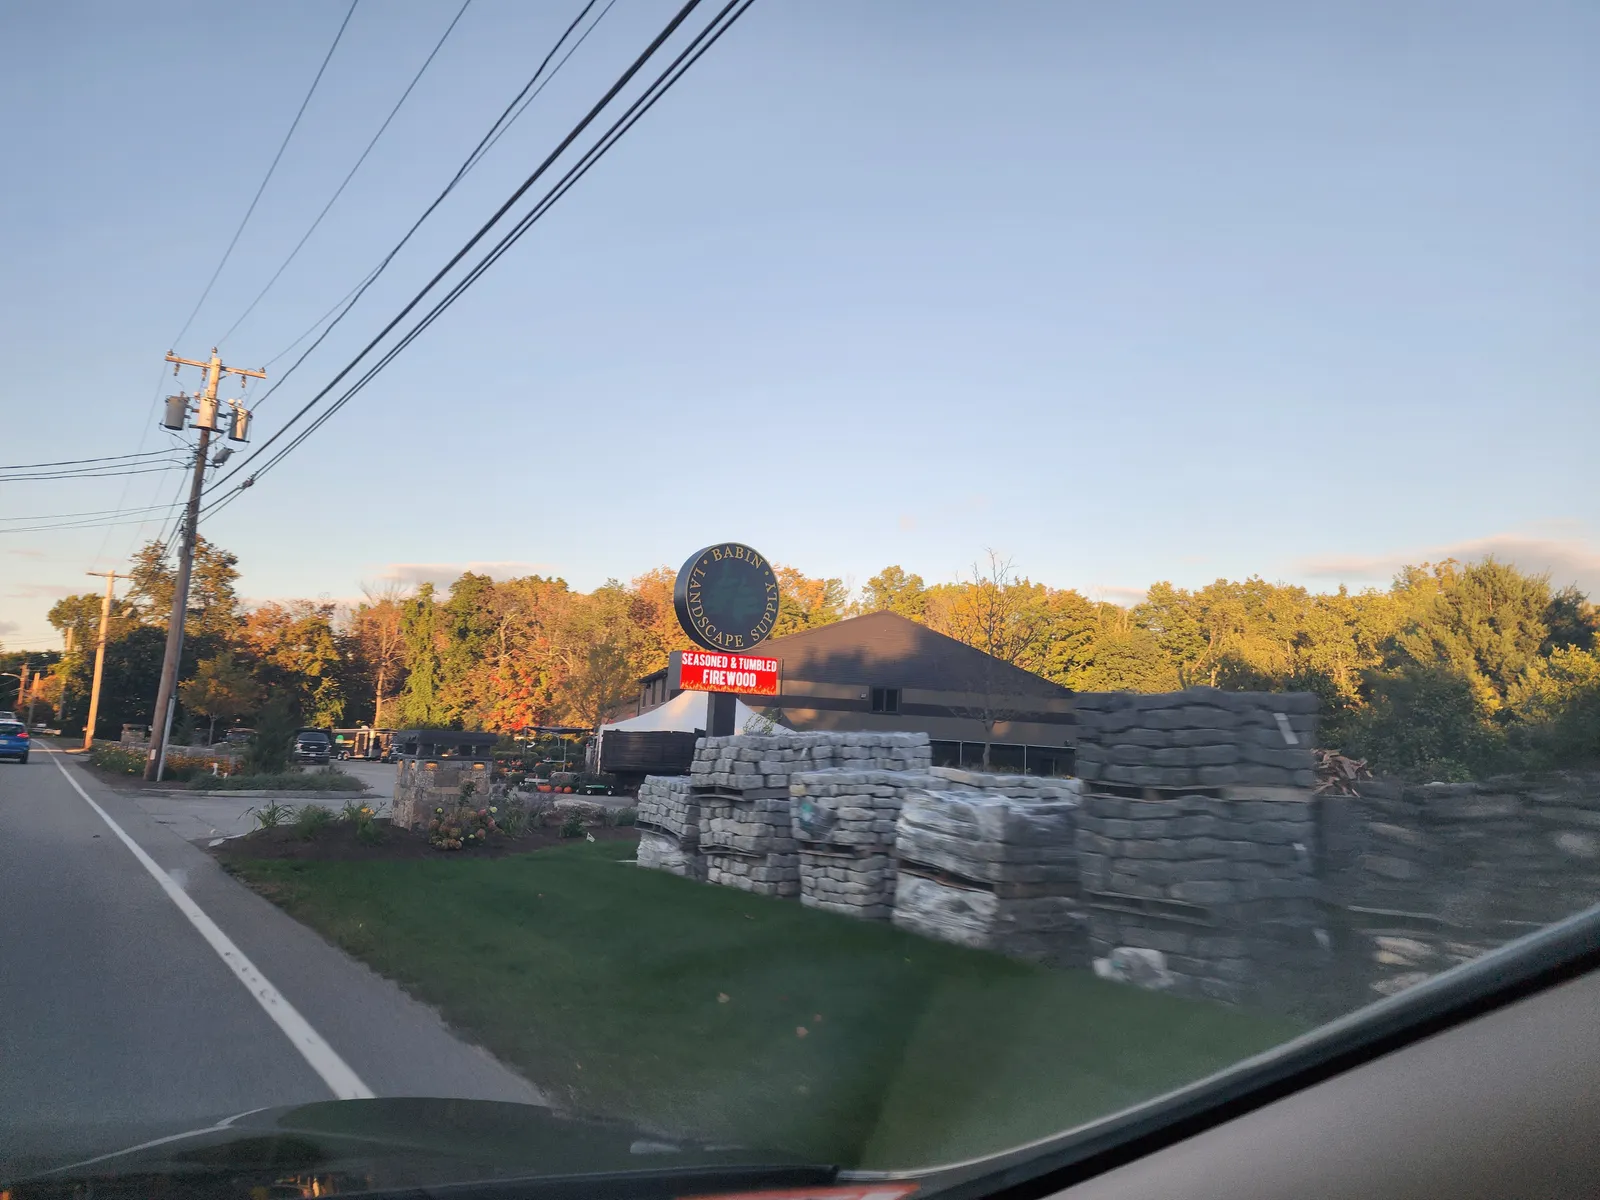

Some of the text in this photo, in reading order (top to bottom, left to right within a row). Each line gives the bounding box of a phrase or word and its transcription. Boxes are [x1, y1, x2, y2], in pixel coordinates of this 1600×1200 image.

[711, 545, 764, 569] BABIN
[689, 566, 778, 648] LANDSCAPE SUPPLY
[682, 652, 777, 672] SEASONED & TUMBLED
[702, 669, 757, 687] FIREWOOD
